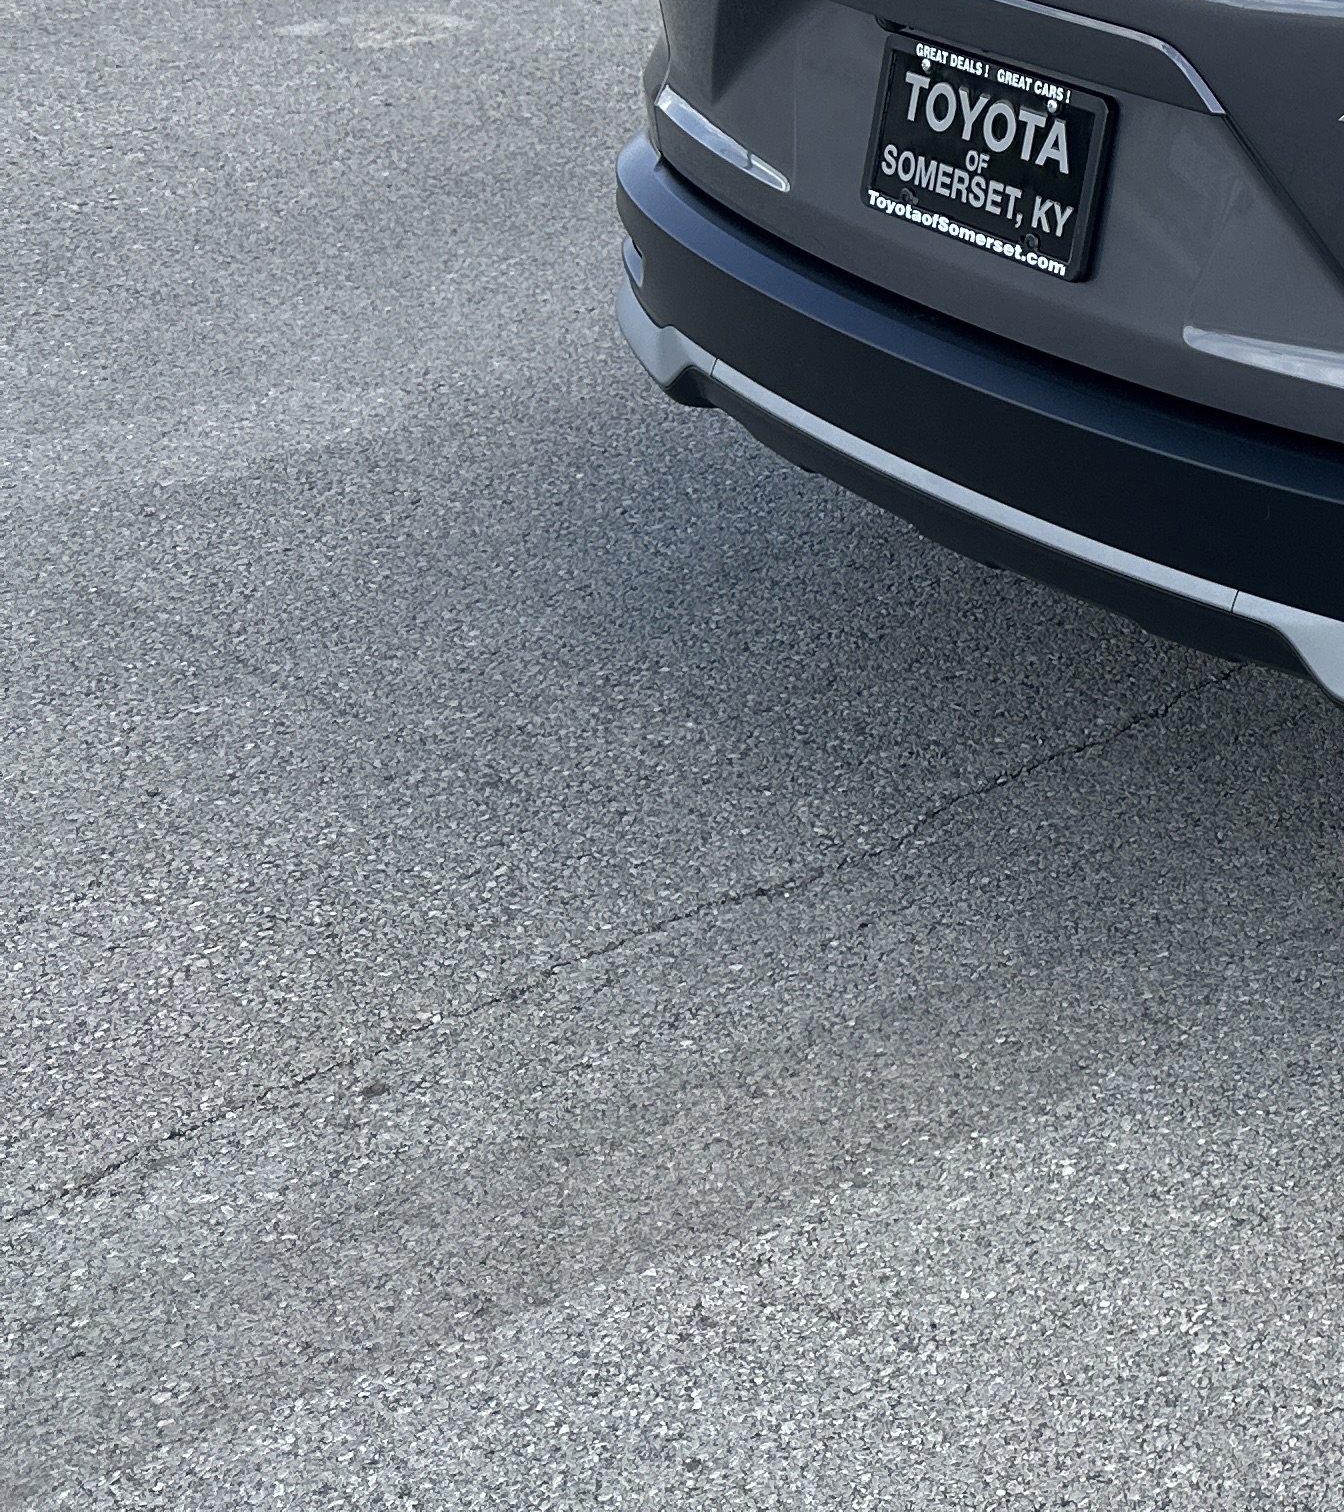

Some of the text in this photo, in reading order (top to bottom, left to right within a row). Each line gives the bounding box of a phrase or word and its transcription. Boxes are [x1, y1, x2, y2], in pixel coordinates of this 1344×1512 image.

[915, 42, 949, 66] GREAT
[996, 68, 1033, 92] GREAT
[904, 71, 1070, 174] TOYOTA
[965, 149, 990, 174] OF
[867, 189, 1067, 276] ToyotaofSomerset.com
[880, 144, 1075, 238] SOMERSET, KY
